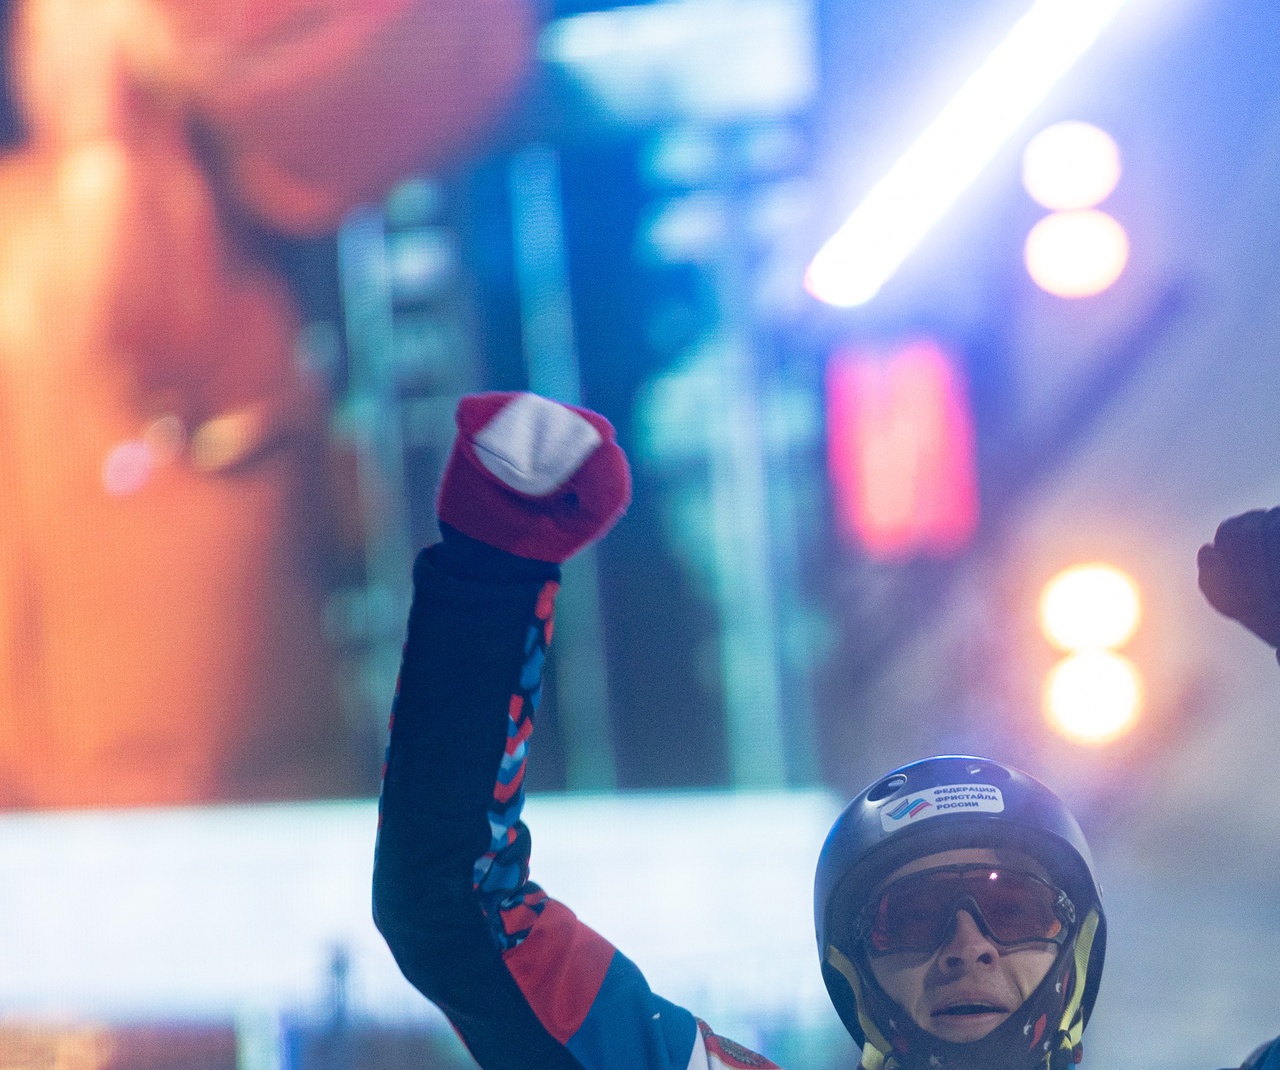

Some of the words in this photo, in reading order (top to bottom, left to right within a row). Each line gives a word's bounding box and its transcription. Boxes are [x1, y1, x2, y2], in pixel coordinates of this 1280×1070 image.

[933, 787, 997, 795] ФЕДЕРАЦИЯ
[935, 794, 998, 802] ФРИСТАЙЛА
[936, 801, 979, 810] РОССИИ
